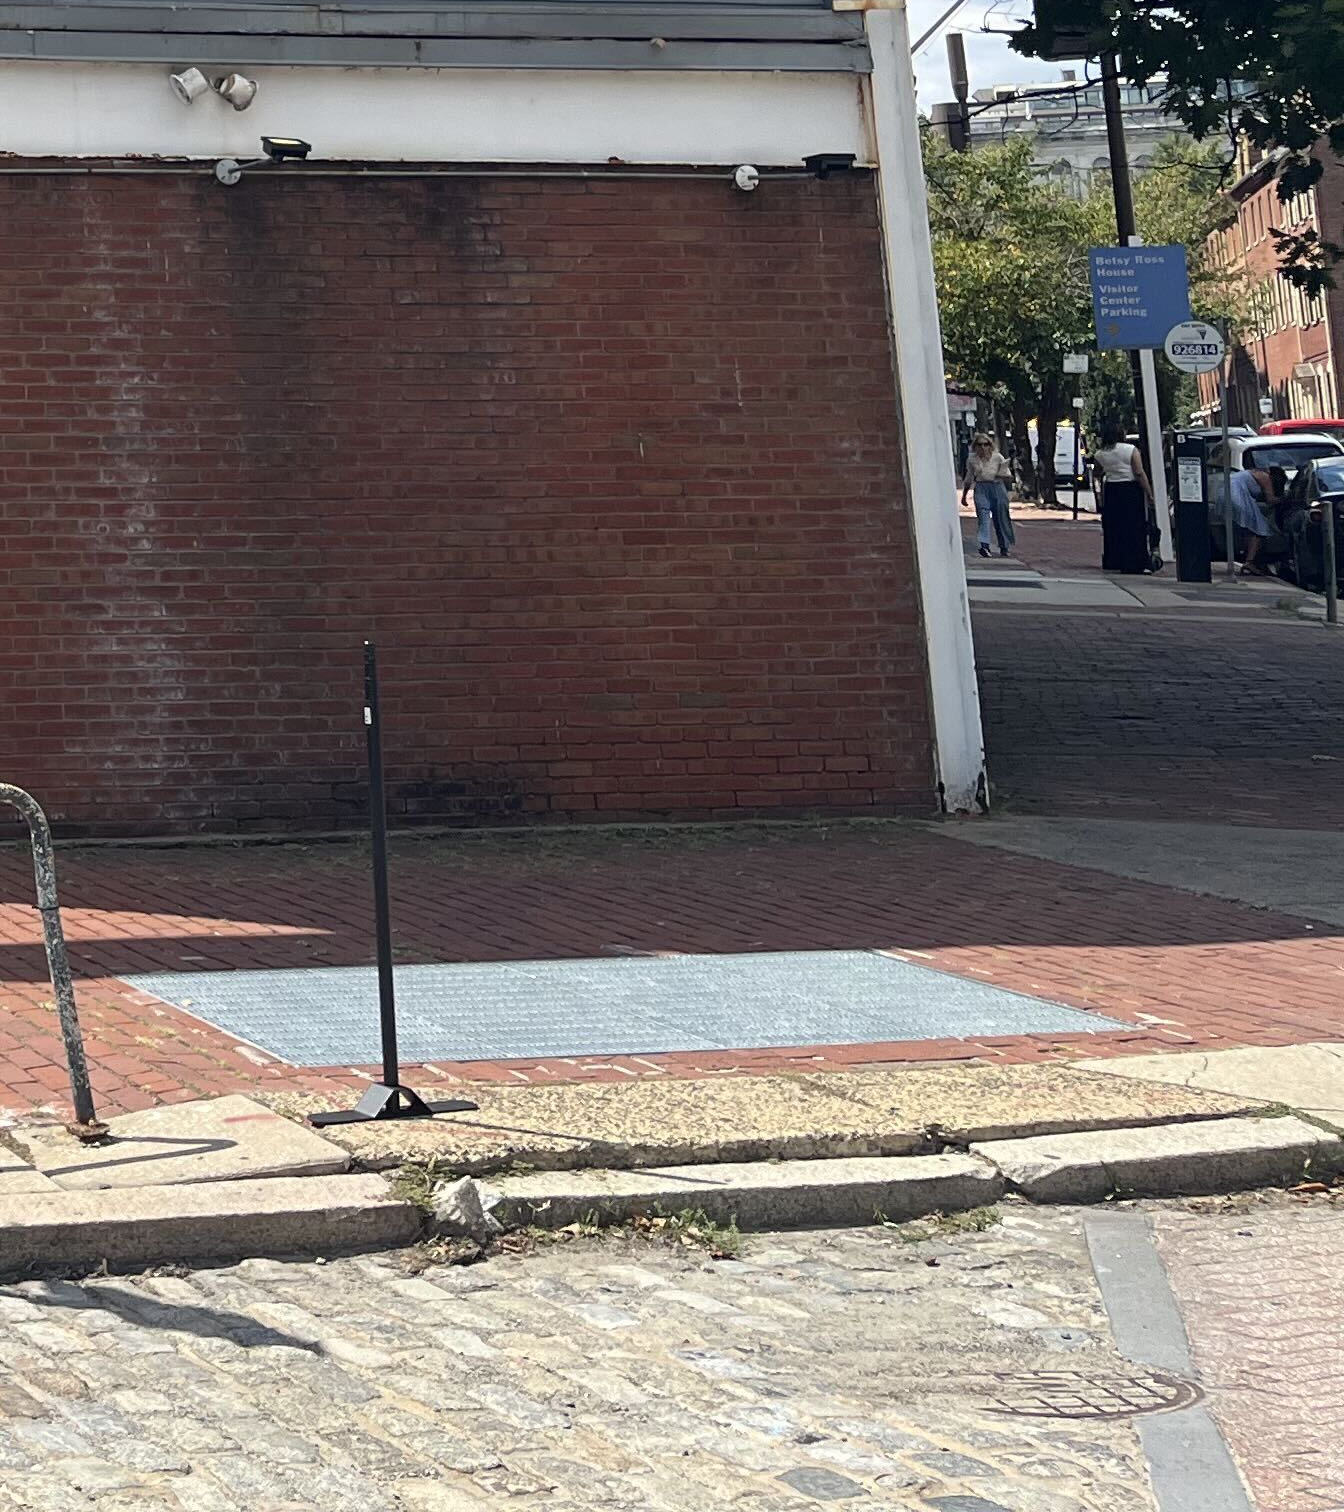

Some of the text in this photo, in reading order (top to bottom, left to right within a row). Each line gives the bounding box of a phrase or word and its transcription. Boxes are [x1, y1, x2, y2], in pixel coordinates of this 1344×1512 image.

[1095, 255, 1165, 266] Betsy Ross
[1096, 268, 1135, 277] House
[1099, 284, 1139, 294] Visitor
[1099, 296, 1141, 305] Center
[1100, 307, 1148, 317] Parking
[1173, 344, 1217, 355] 926814
